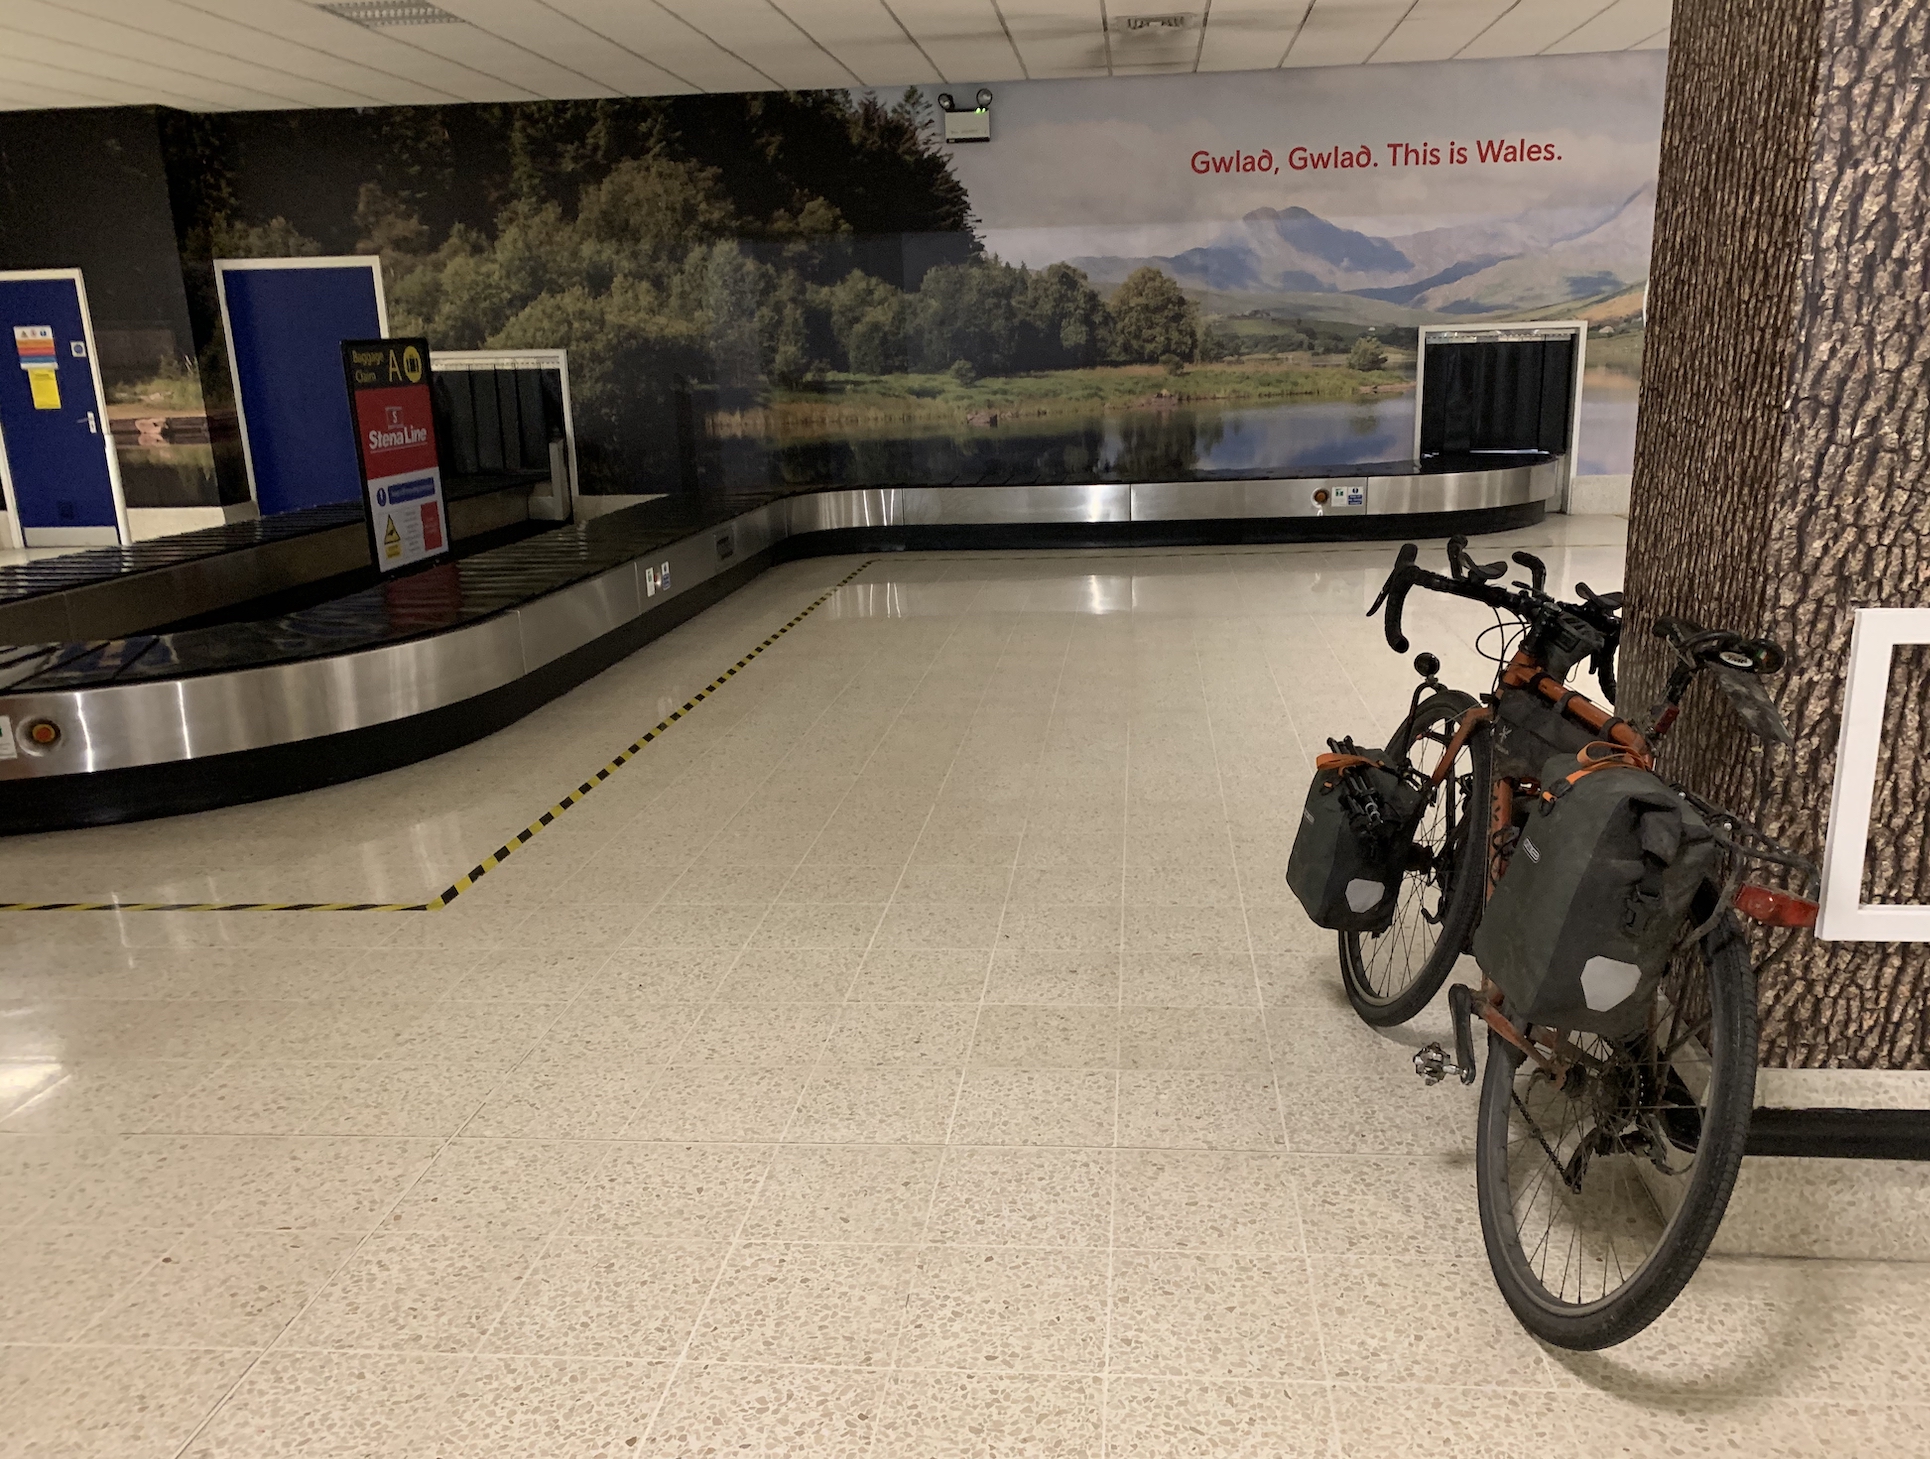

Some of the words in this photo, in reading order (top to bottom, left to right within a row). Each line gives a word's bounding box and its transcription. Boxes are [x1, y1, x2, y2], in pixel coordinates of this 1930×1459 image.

[1387, 142, 1441, 166] This
[1449, 141, 1468, 165] is
[1476, 138, 1562, 163] Wales.
[389, 349, 402, 382] A
